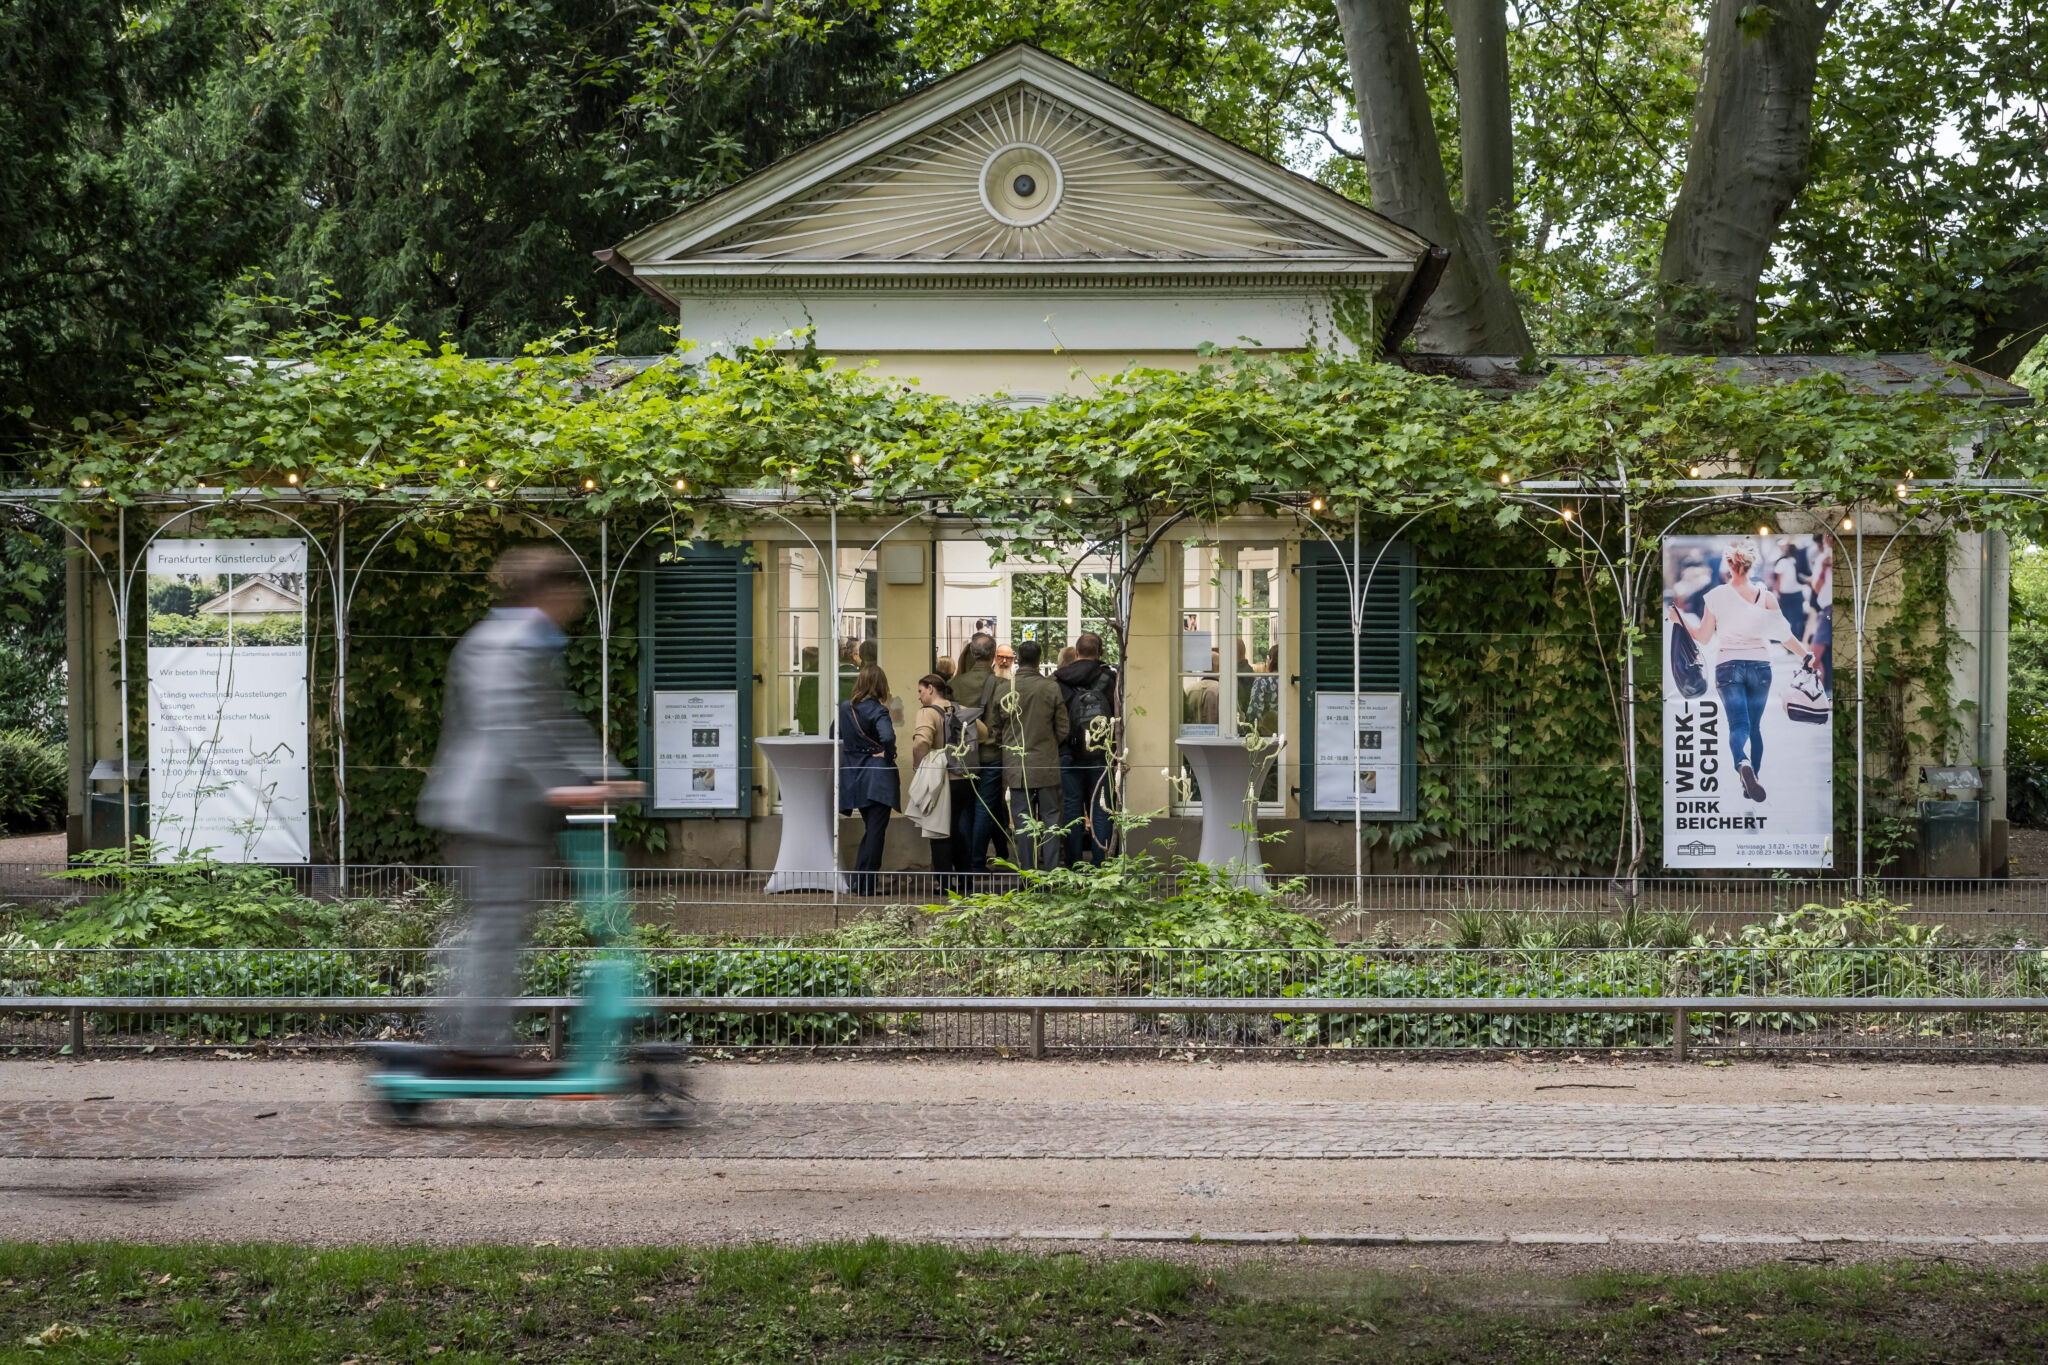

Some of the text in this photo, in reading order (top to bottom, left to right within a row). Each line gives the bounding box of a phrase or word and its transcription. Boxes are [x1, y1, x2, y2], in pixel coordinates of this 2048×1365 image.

[158, 555, 212, 563] Frankfurter
[215, 554, 276, 563] Künstlerclub
[290, 553, 299, 562] V.
[160, 691, 186, 699] ständig
[235, 691, 287, 699] Ausstellungen
[1675, 701, 1694, 793] WERK-
[1700, 701, 1718, 792] SCHAU
[209, 758, 239, 766] Sonntag
[1676, 801, 1720, 813] DIRK
[1676, 817, 1767, 829] BEICHERT
